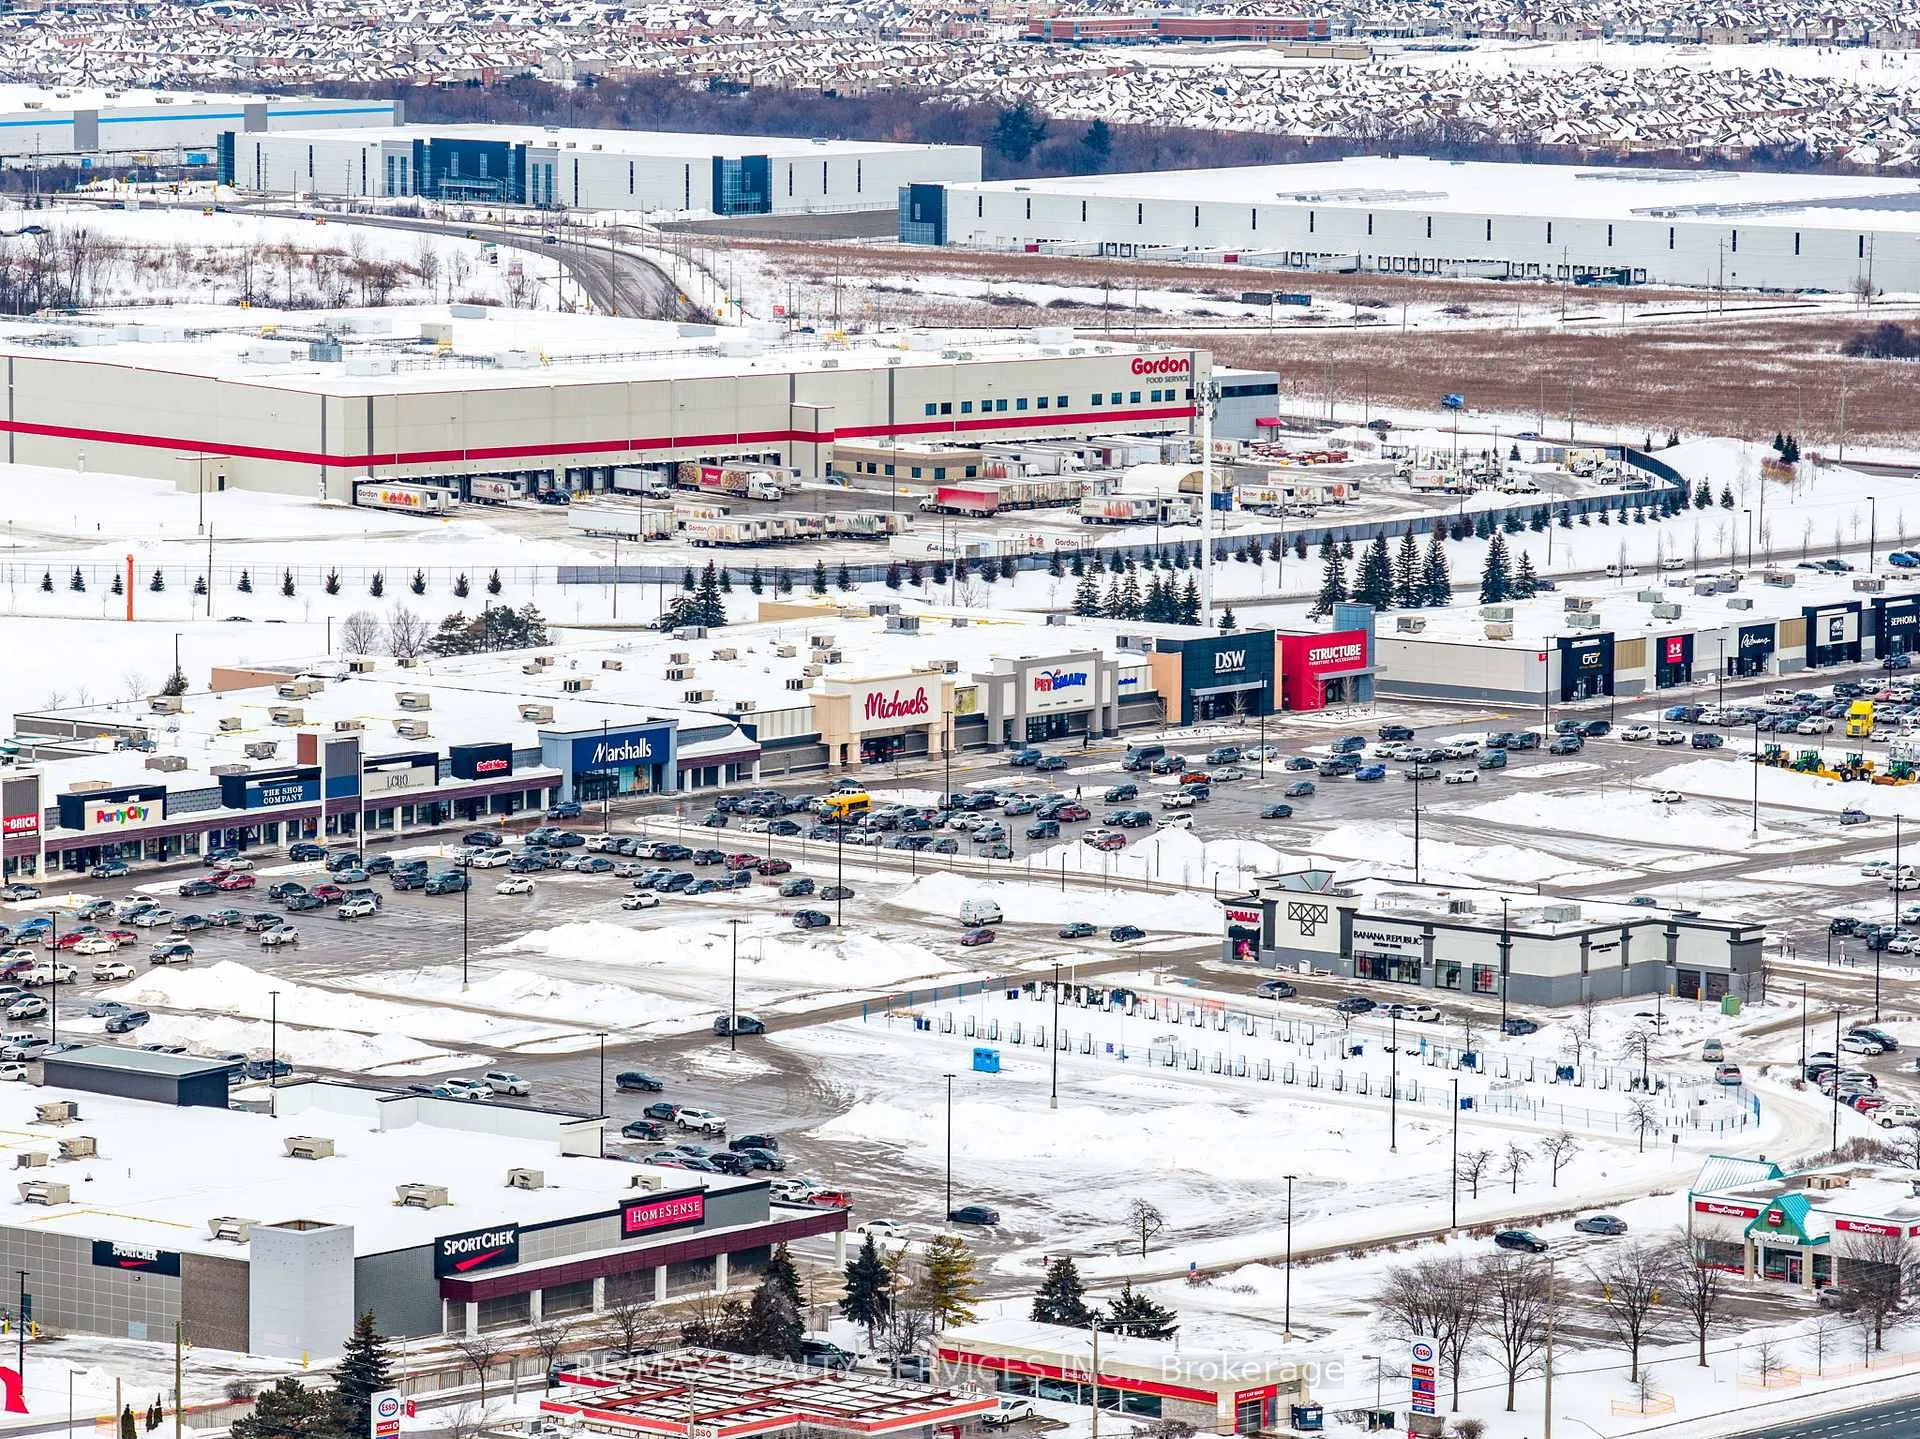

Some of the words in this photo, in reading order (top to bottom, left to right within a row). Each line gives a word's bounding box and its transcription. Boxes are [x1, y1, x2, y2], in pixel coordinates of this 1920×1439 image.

[1131, 356, 1190, 375] Gordon
[358, 489, 378, 498] Gordon
[1055, 538, 1080, 547] Gordon
[1890, 615, 1917, 626] SEPHORA
[1214, 649, 1246, 669] DSW
[1309, 644, 1361, 661] STRUCTUBE
[864, 687, 929, 720] Michaels
[592, 737, 652, 764] Marshalls
[263, 788, 280, 797] THE
[282, 785, 304, 795] SHOE
[263, 793, 303, 805] COMPANY
[10, 816, 37, 829] BRICK
[1353, 930, 1385, 942] BANANA
[1385, 934, 1423, 946] REPUBLIC
